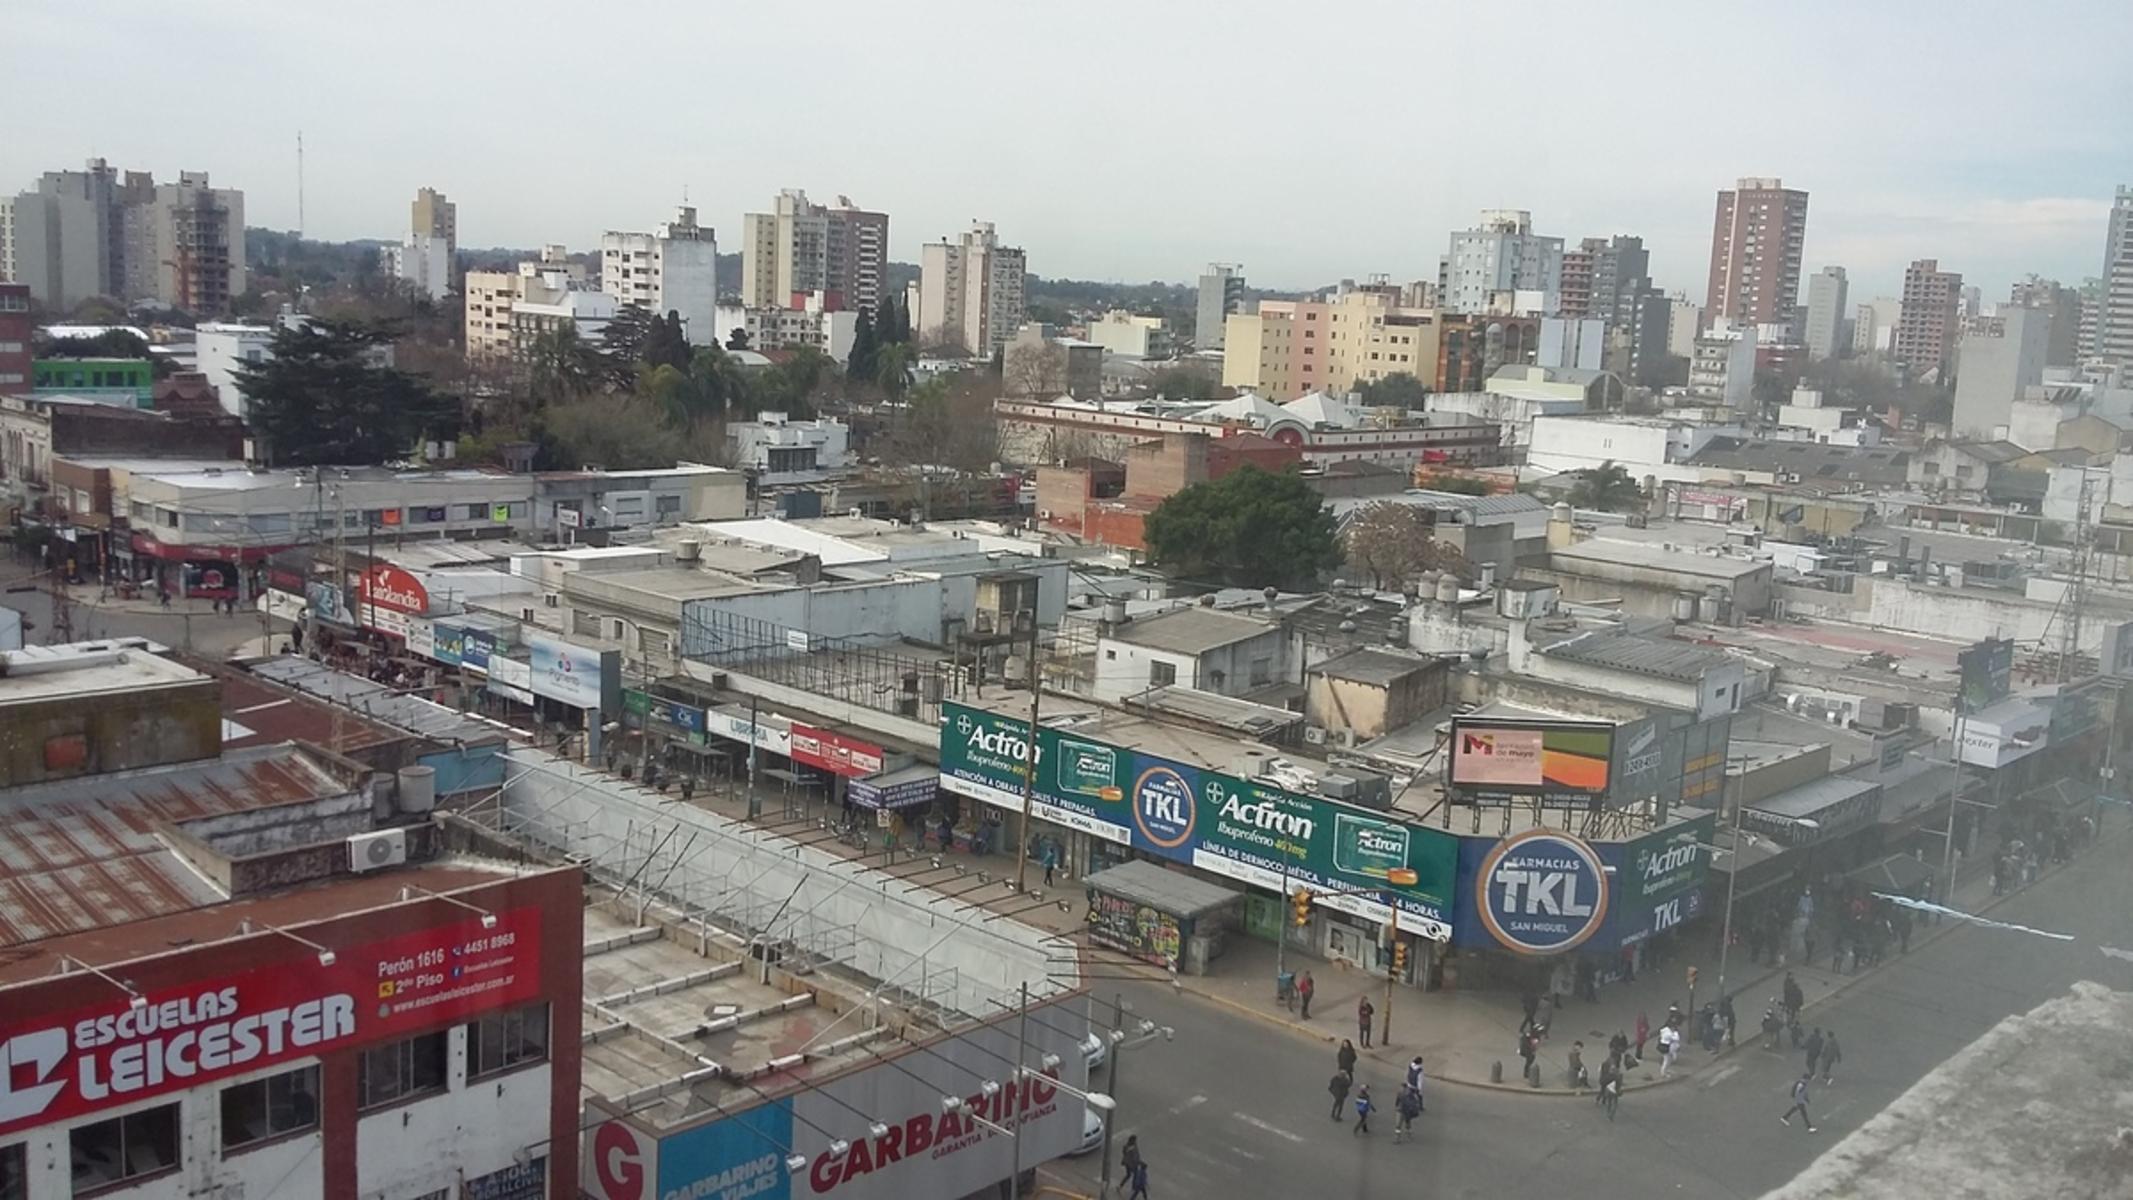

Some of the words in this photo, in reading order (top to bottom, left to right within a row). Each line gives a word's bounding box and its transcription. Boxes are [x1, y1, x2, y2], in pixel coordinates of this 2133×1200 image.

[989, 777, 994, 787] A
[995, 780, 1020, 794] OBRAS
[1142, 788, 1187, 827] TKL
[1218, 793, 1313, 840] Actron
[1217, 820, 1274, 848] Ibuprofeno
[1643, 844, 1697, 880] Actron
[1228, 848, 1239, 859] DE
[1241, 852, 1321, 885] DERMOCOMÉTICA.
[1405, 901, 1442, 921] HORAS.
[1496, 869, 1592, 917] TKL
[1510, 920, 1533, 931] SAN
[1533, 922, 1569, 934] MIGUEL
[1654, 898, 1682, 932] TKL
[378, 955, 415, 977] Perón
[417, 948, 445, 968] 1616
[464, 939, 489, 955] 4451
[415, 973, 444, 989] Piso
[74, 986, 238, 1050] ESCUELAS
[78, 993, 355, 1101] LEICESTER
